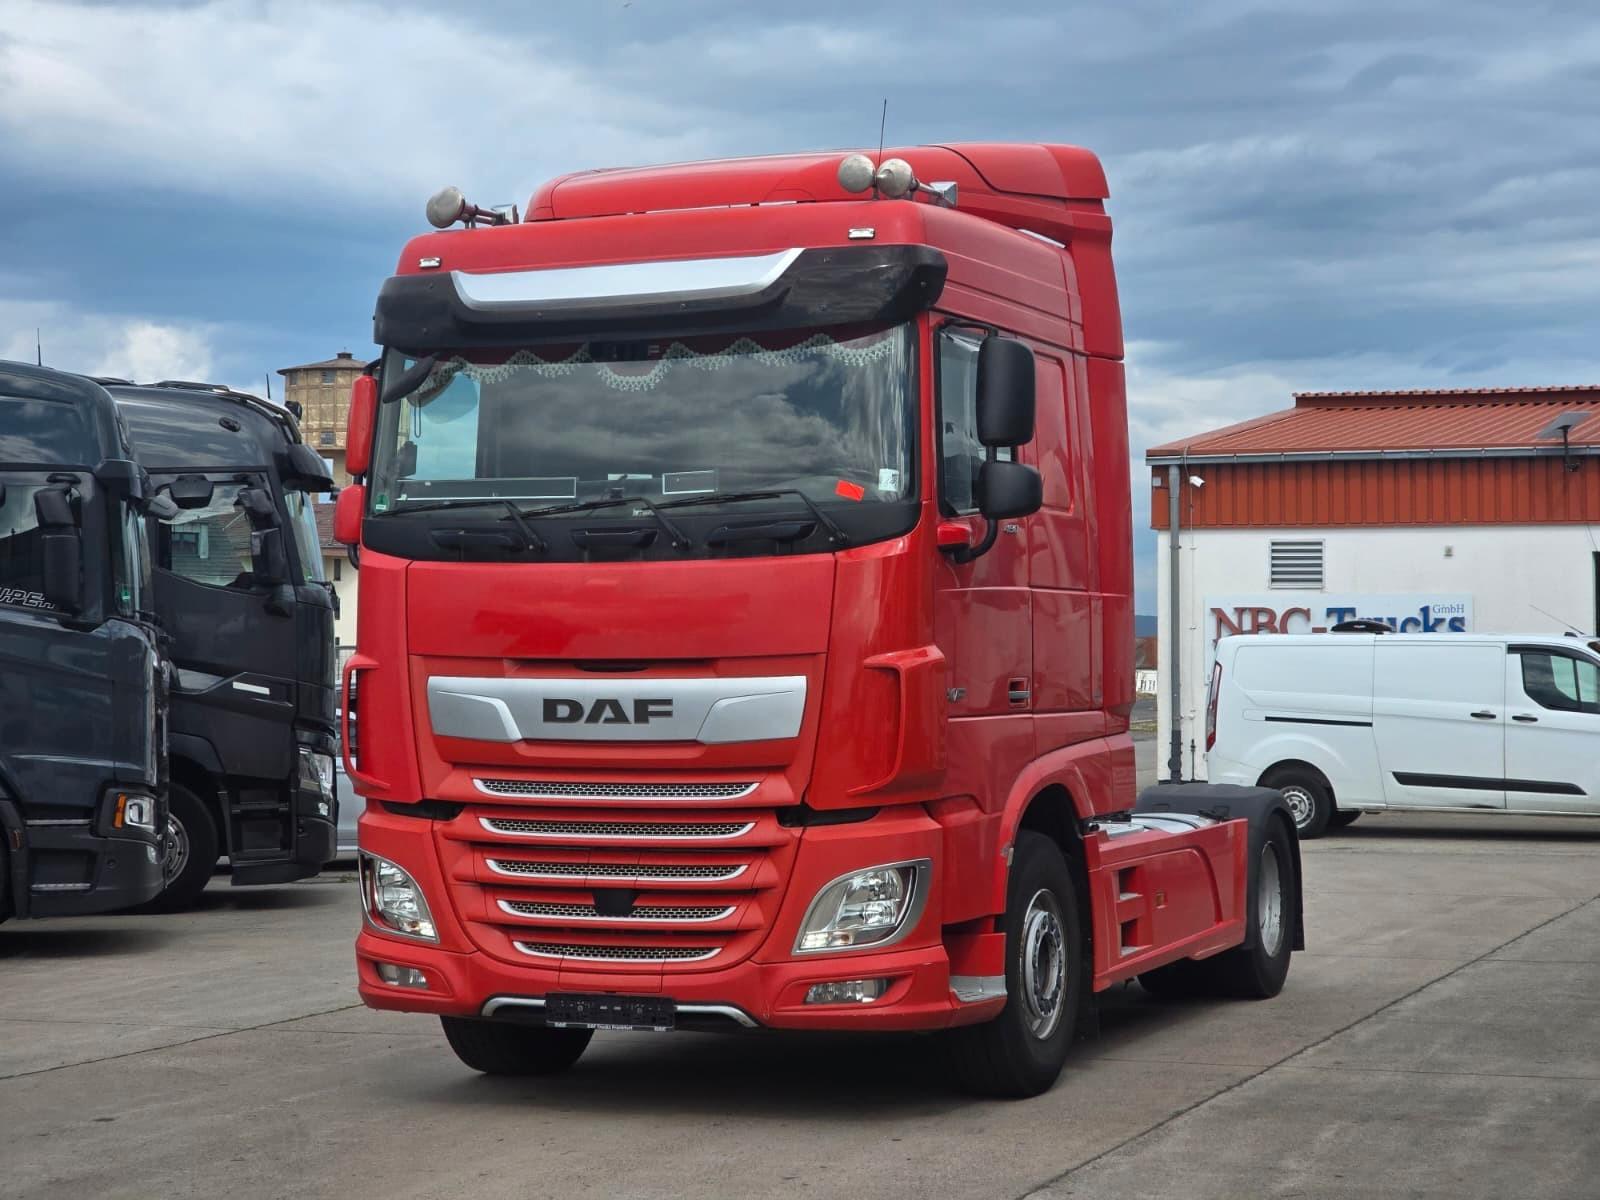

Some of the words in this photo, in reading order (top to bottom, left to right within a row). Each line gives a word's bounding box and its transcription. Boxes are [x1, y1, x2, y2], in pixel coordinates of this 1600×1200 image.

[1432, 603, 1465, 614] GmbH
[1209, 605, 1466, 642] NBC-Tcks
[542, 697, 673, 725] DAF
